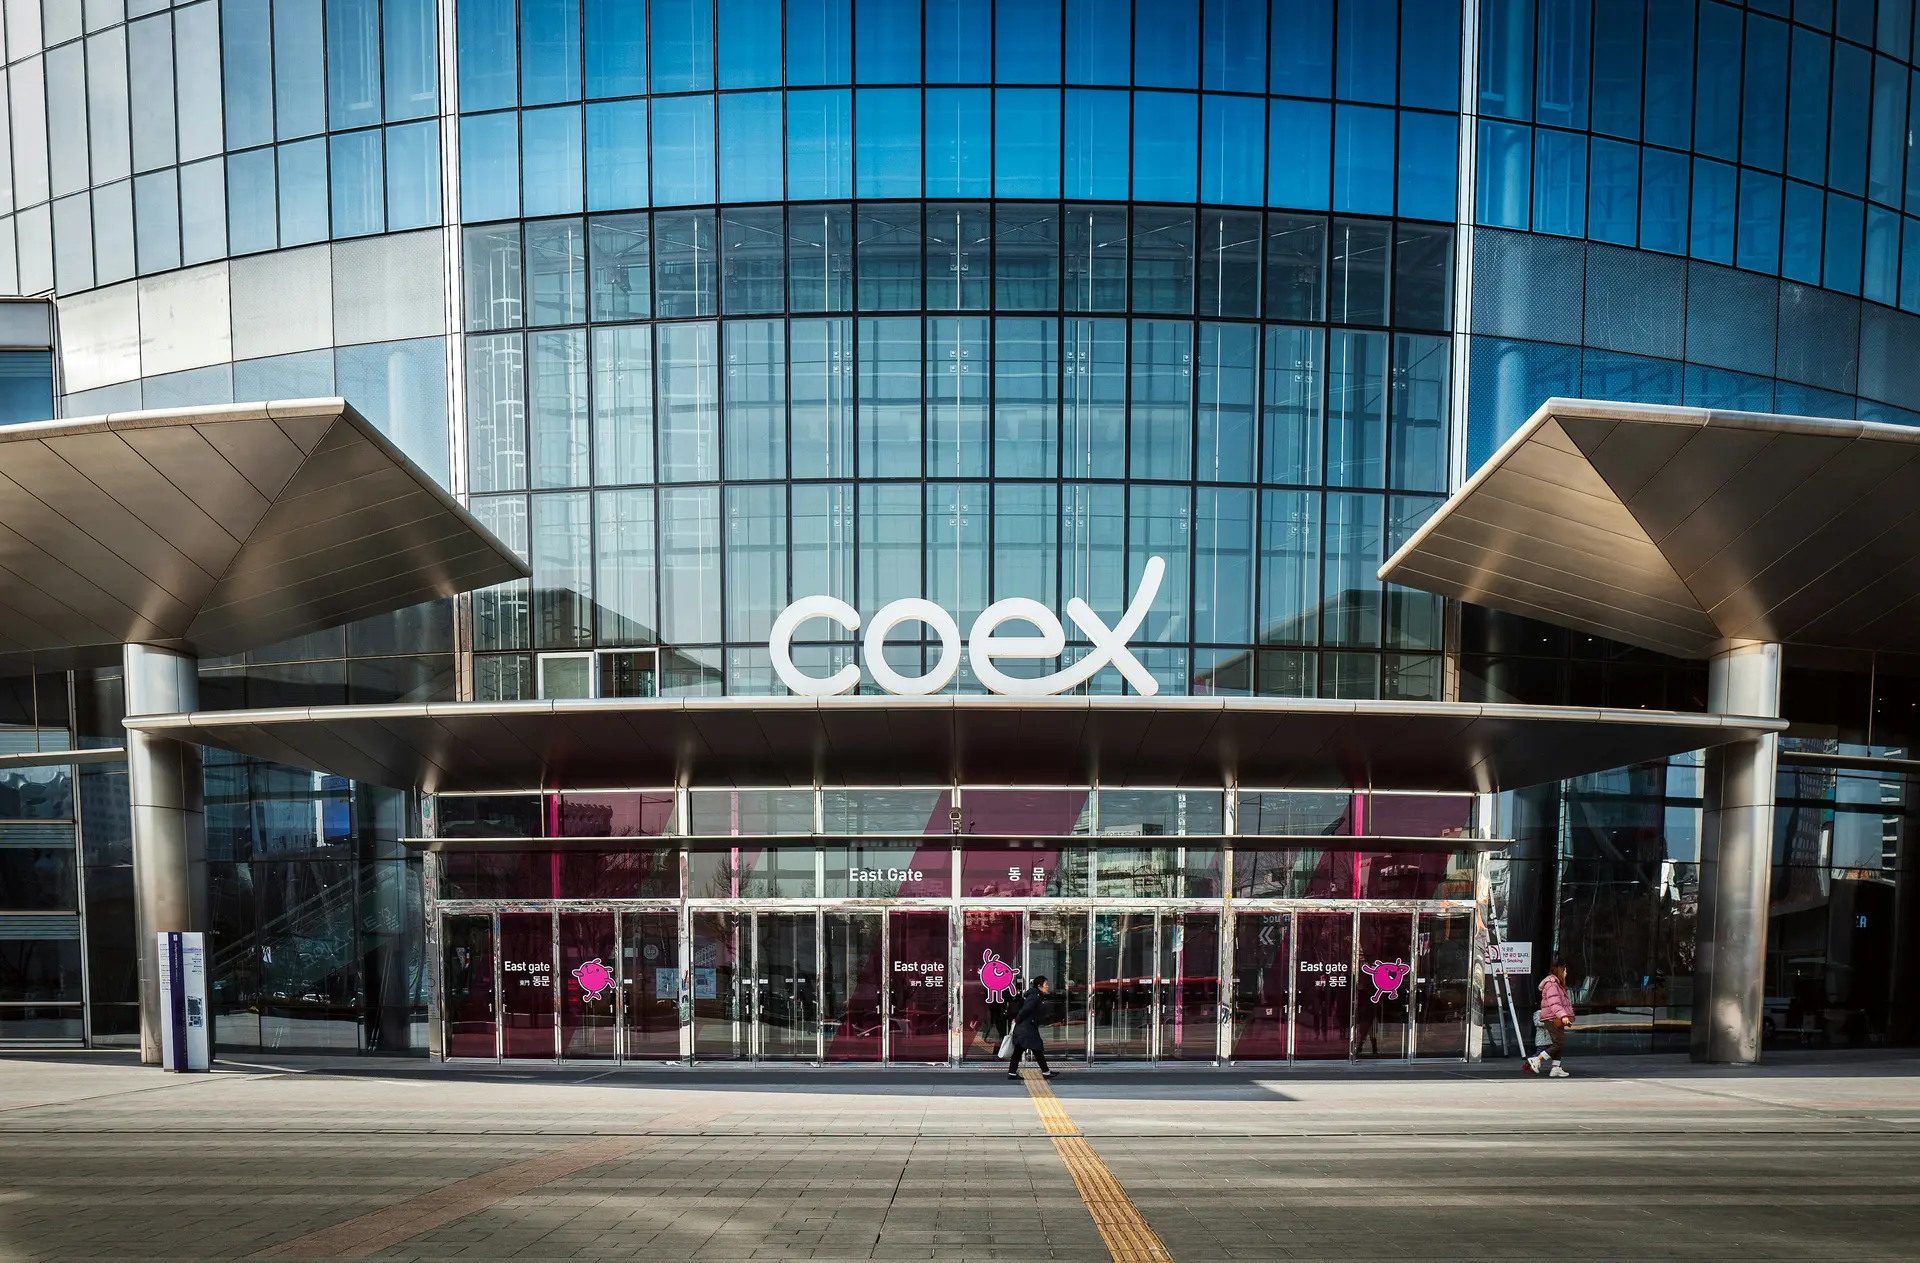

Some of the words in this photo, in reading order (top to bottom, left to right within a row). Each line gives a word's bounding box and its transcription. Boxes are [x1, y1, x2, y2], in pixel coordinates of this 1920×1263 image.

[769, 556, 1165, 696] coex
[848, 867, 883, 882] East
[887, 867, 924, 882] Gate
[1008, 867, 1021, 882] 동
[1032, 867, 1045, 882] 문
[504, 961, 527, 972] East
[528, 961, 550, 974] gate
[894, 961, 918, 972] East
[920, 961, 945, 974] gate
[1300, 961, 1323, 972] East
[1325, 961, 1348, 974] gate
[532, 975, 551, 987] 동문
[924, 975, 944, 988] 동문
[1329, 975, 1347, 987] 동문
